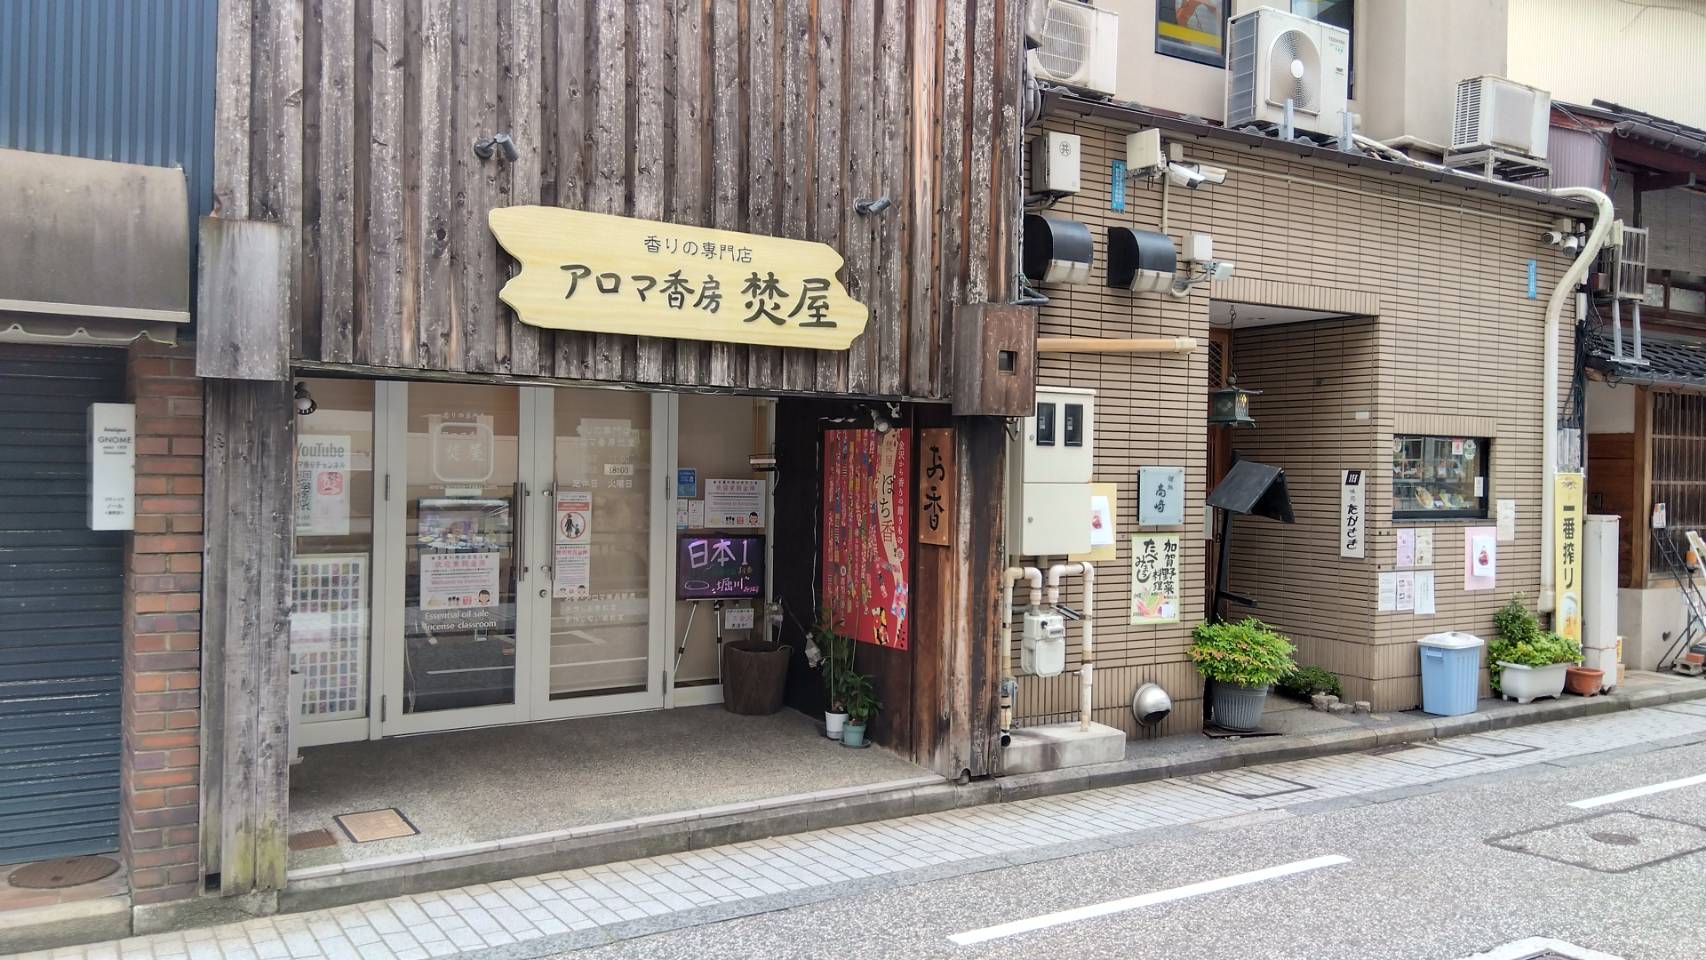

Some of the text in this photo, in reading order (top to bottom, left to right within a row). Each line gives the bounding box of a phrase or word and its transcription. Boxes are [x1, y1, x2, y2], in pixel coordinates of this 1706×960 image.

[644, 235, 753, 264] 香りの専門店
[560, 264, 837, 328] アロマ香房 焚屋
[924, 446, 945, 531] お香
[1163, 538, 1177, 594] 加賀野菜
[1563, 505, 1575, 589] 一番搾り
[1152, 568, 1162, 591] 料理
[425, 611, 460, 620] Essential
[461, 610, 471, 618] oil
[458, 621, 496, 629] classroom
